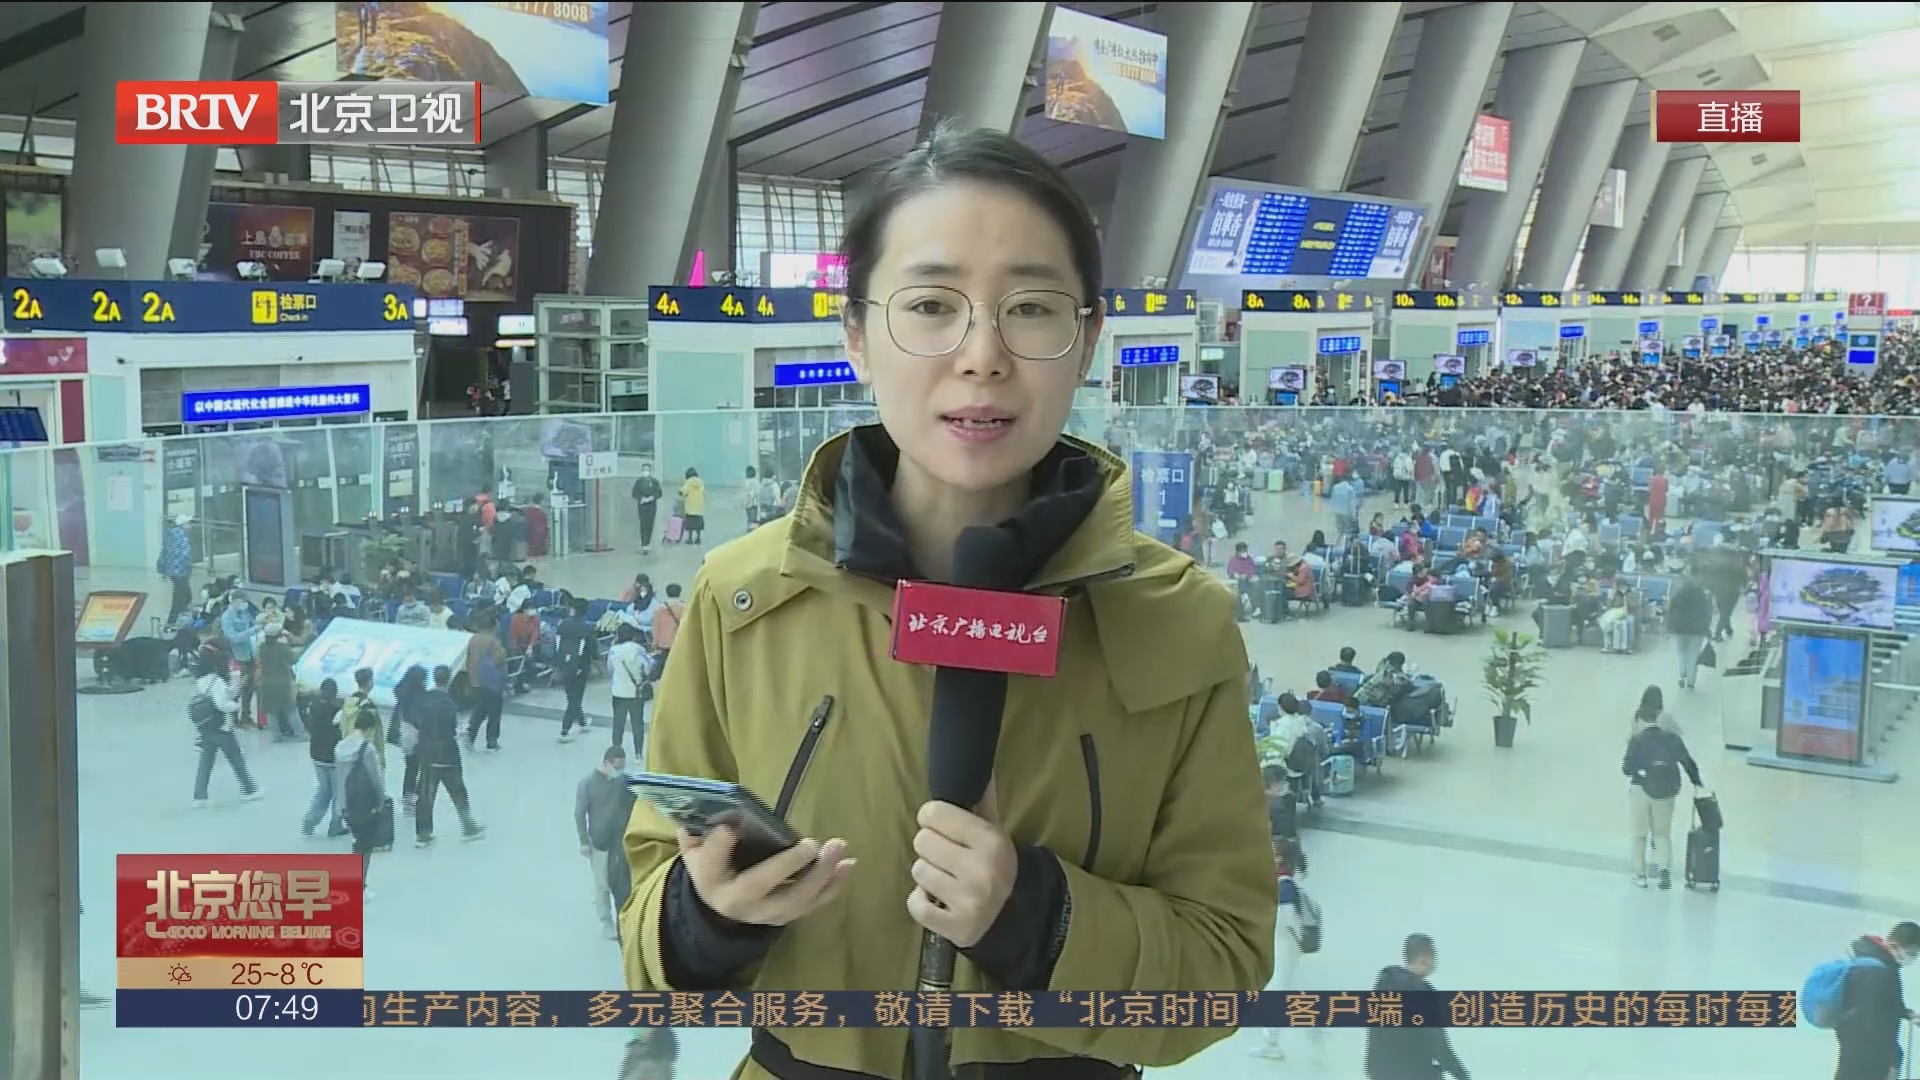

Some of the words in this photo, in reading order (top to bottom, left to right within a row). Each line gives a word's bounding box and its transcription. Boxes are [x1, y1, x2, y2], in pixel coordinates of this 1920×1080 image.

[553, 2, 589, 21] 8008
[267, 250, 301, 260] COFFEE
[13, 288, 43, 319] 2A
[92, 291, 121, 322] 2A
[143, 291, 175, 322] 2A
[280, 293, 317, 310] 检票口
[383, 294, 409, 321] 3A
[656, 293, 680, 315] 4A
[721, 293, 744, 316] 4A
[757, 294, 774, 316] 4A
[1247, 292, 1264, 308] 8A
[1292, 293, 1311, 309] 8A
[1395, 293, 1415, 306] 10A
[1435, 294, 1455, 306] 10A
[1504, 293, 1523, 305] 12A
[1541, 293, 1558, 305] 12A
[1141, 466, 1184, 484] 检票口
[908, 613, 1048, 645] 北京广播电视台
